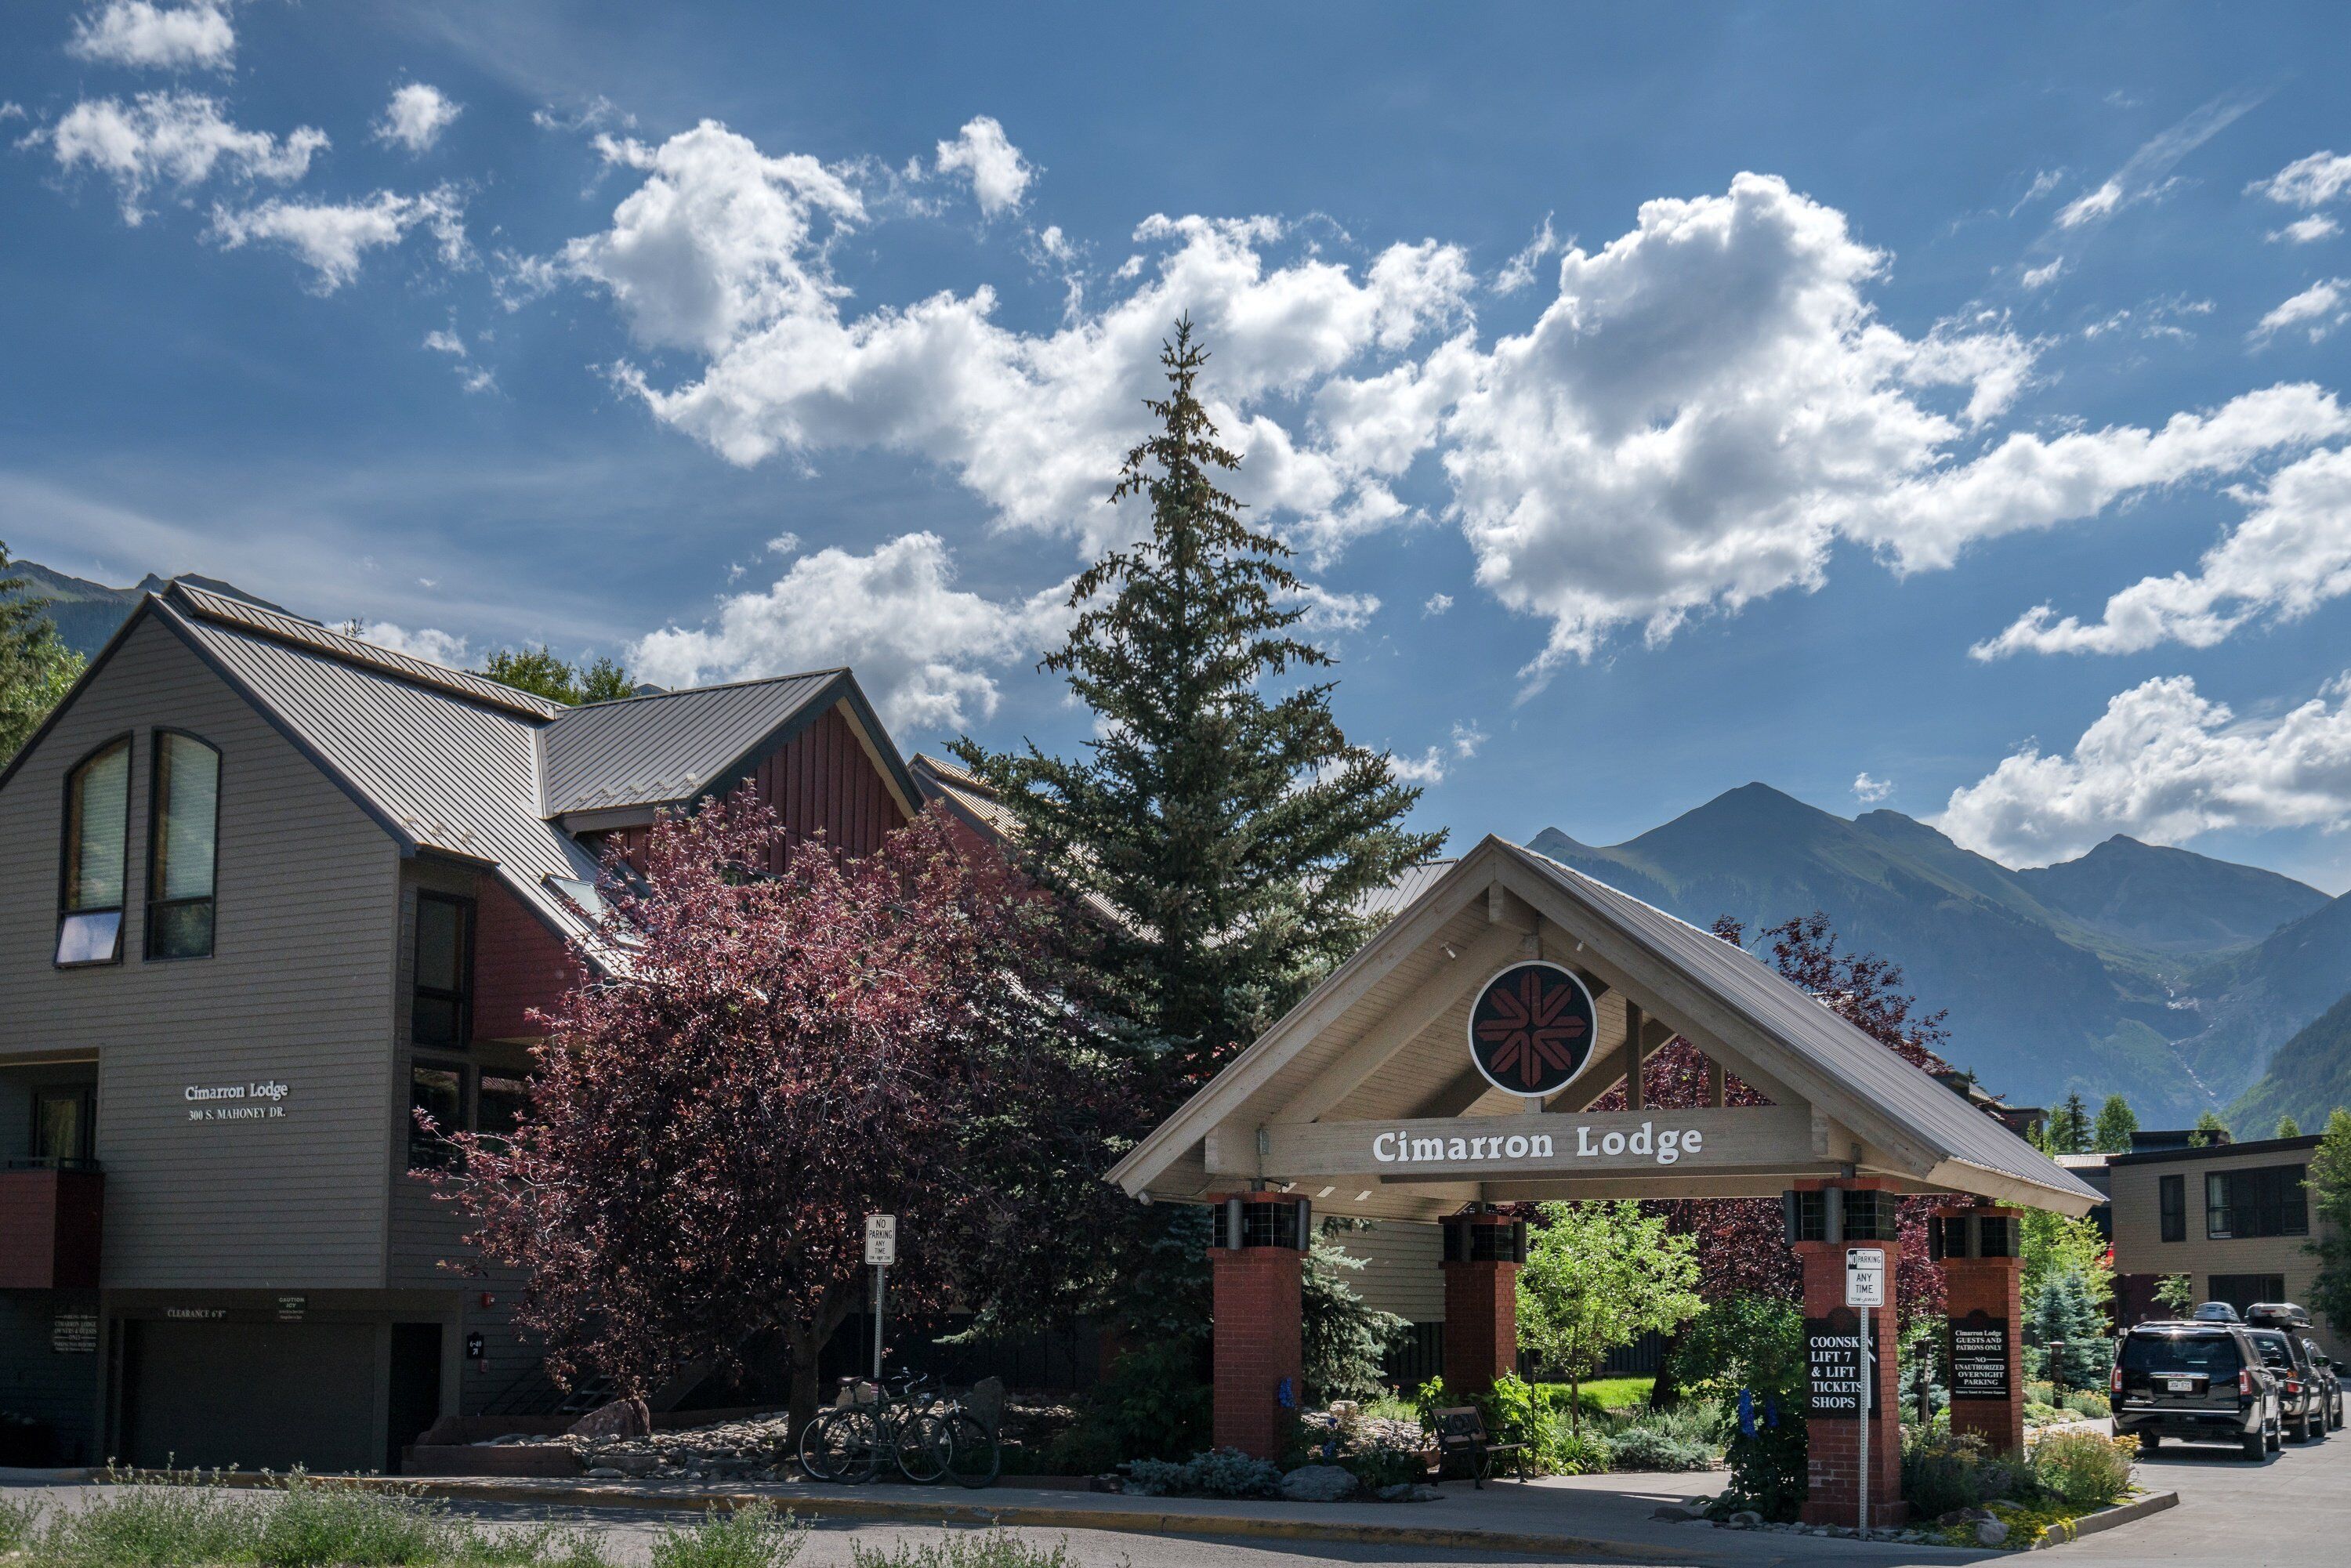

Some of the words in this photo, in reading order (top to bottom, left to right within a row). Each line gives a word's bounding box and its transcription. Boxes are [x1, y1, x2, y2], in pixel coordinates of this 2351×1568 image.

[185, 1085, 245, 1100] Cimarron
[250, 1080, 288, 1101] Lodge
[188, 1110, 204, 1121] 300
[205, 1110, 214, 1120] S.
[217, 1107, 266, 1119] MAHONEY
[270, 1106, 286, 1117] DR.
[1372, 1130, 1554, 1162] Cimarron
[1576, 1121, 1702, 1164] Lodge
[875, 1219, 886, 1229] NO
[868, 1229, 893, 1239] PARKING
[1848, 1254, 1857, 1265] NO
[1856, 1273, 1872, 1282] ANY
[1855, 1284, 1874, 1294] TIME
[1810, 1336, 1874, 1348] COONSKN
[1810, 1351, 1841, 1363] LIFT
[1844, 1351, 1851, 1363] 7
[1811, 1366, 1821, 1377] &
[1826, 1366, 1856, 1378] LIFT
[1812, 1396, 1856, 1408] SHOPS
